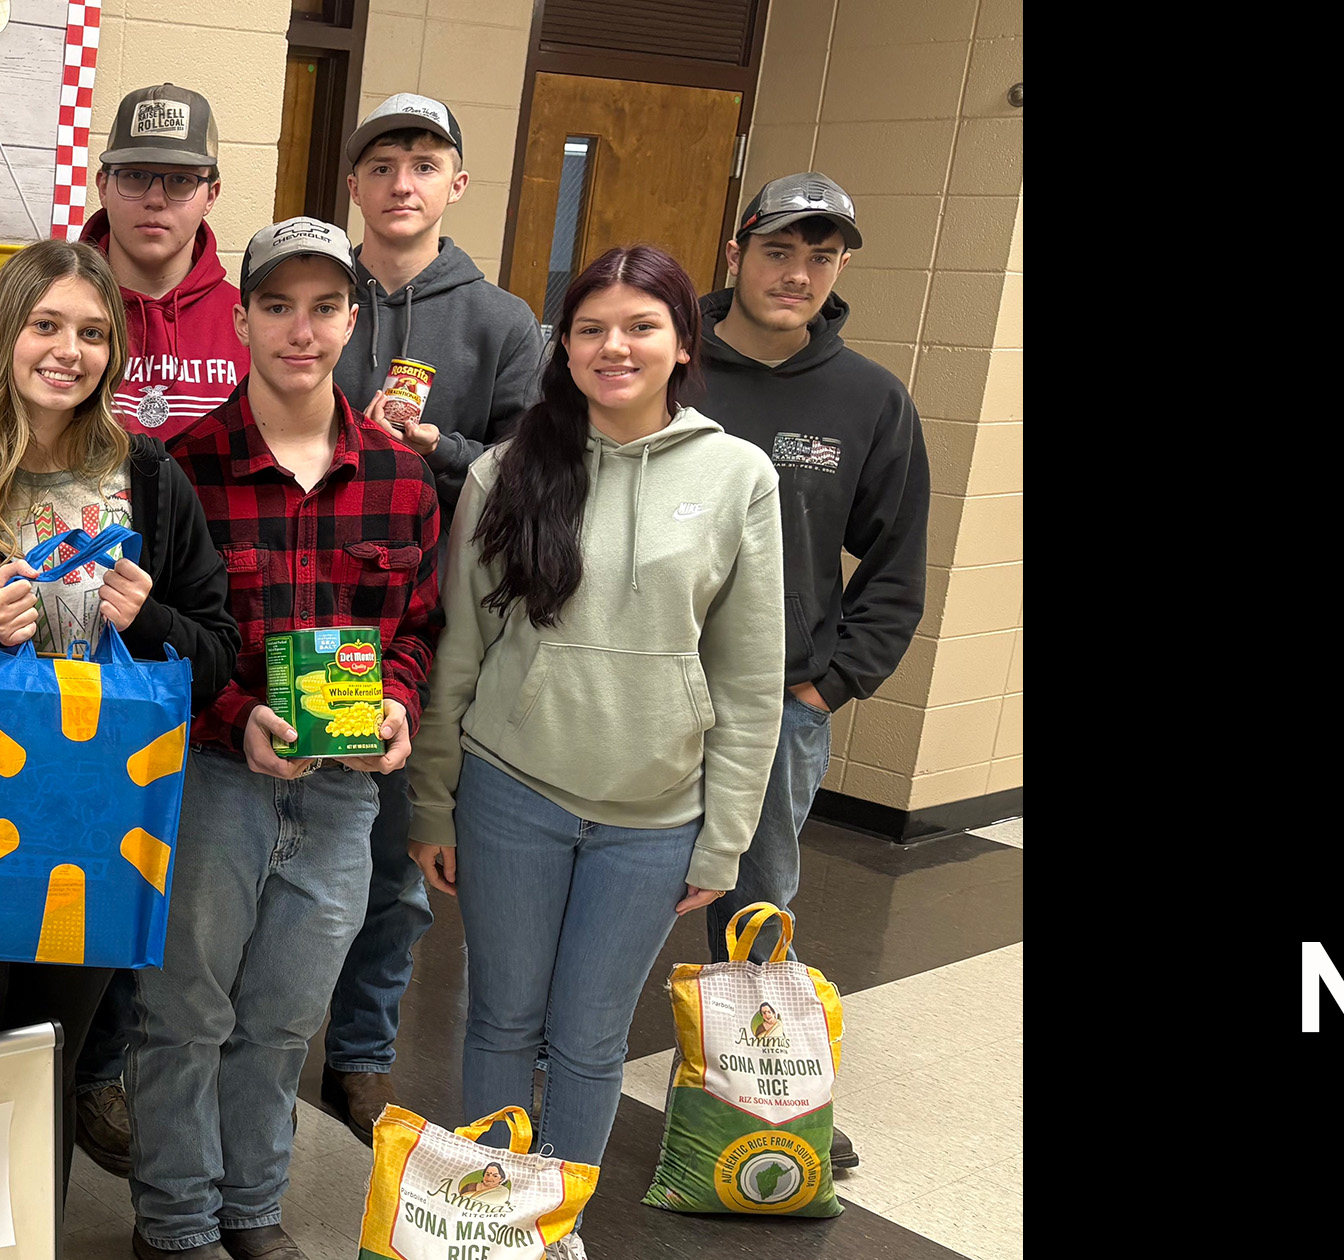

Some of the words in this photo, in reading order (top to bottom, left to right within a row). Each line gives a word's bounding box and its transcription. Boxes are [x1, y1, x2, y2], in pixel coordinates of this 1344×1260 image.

[273, 232, 331, 246] CHEVROLET
[206, 359, 237, 386] FFA
[391, 365, 429, 384] Rosarita
[678, 502, 703, 513] NIKE
[340, 652, 353, 662] Del
[354, 652, 374, 662] Monte
[329, 687, 353, 696] Whole
[355, 687, 373, 696] Kernel
[719, 1053, 756, 1075] SONA
[759, 1058, 823, 1076] MASOORI
[757, 1078, 790, 1096] RICE
[753, 1097, 773, 1106] SONA
[722, 1144, 749, 1184] AUTHENTIC
[747, 1136, 768, 1150] RICE
[770, 1136, 794, 1149] FROM
[793, 1144, 815, 1168] SOUTH
[427, 1178, 517, 1213] Amma's
[405, 1202, 448, 1240] SONA
[456, 1221, 535, 1248] MASOORI
[448, 1245, 491, 1260] RICE
